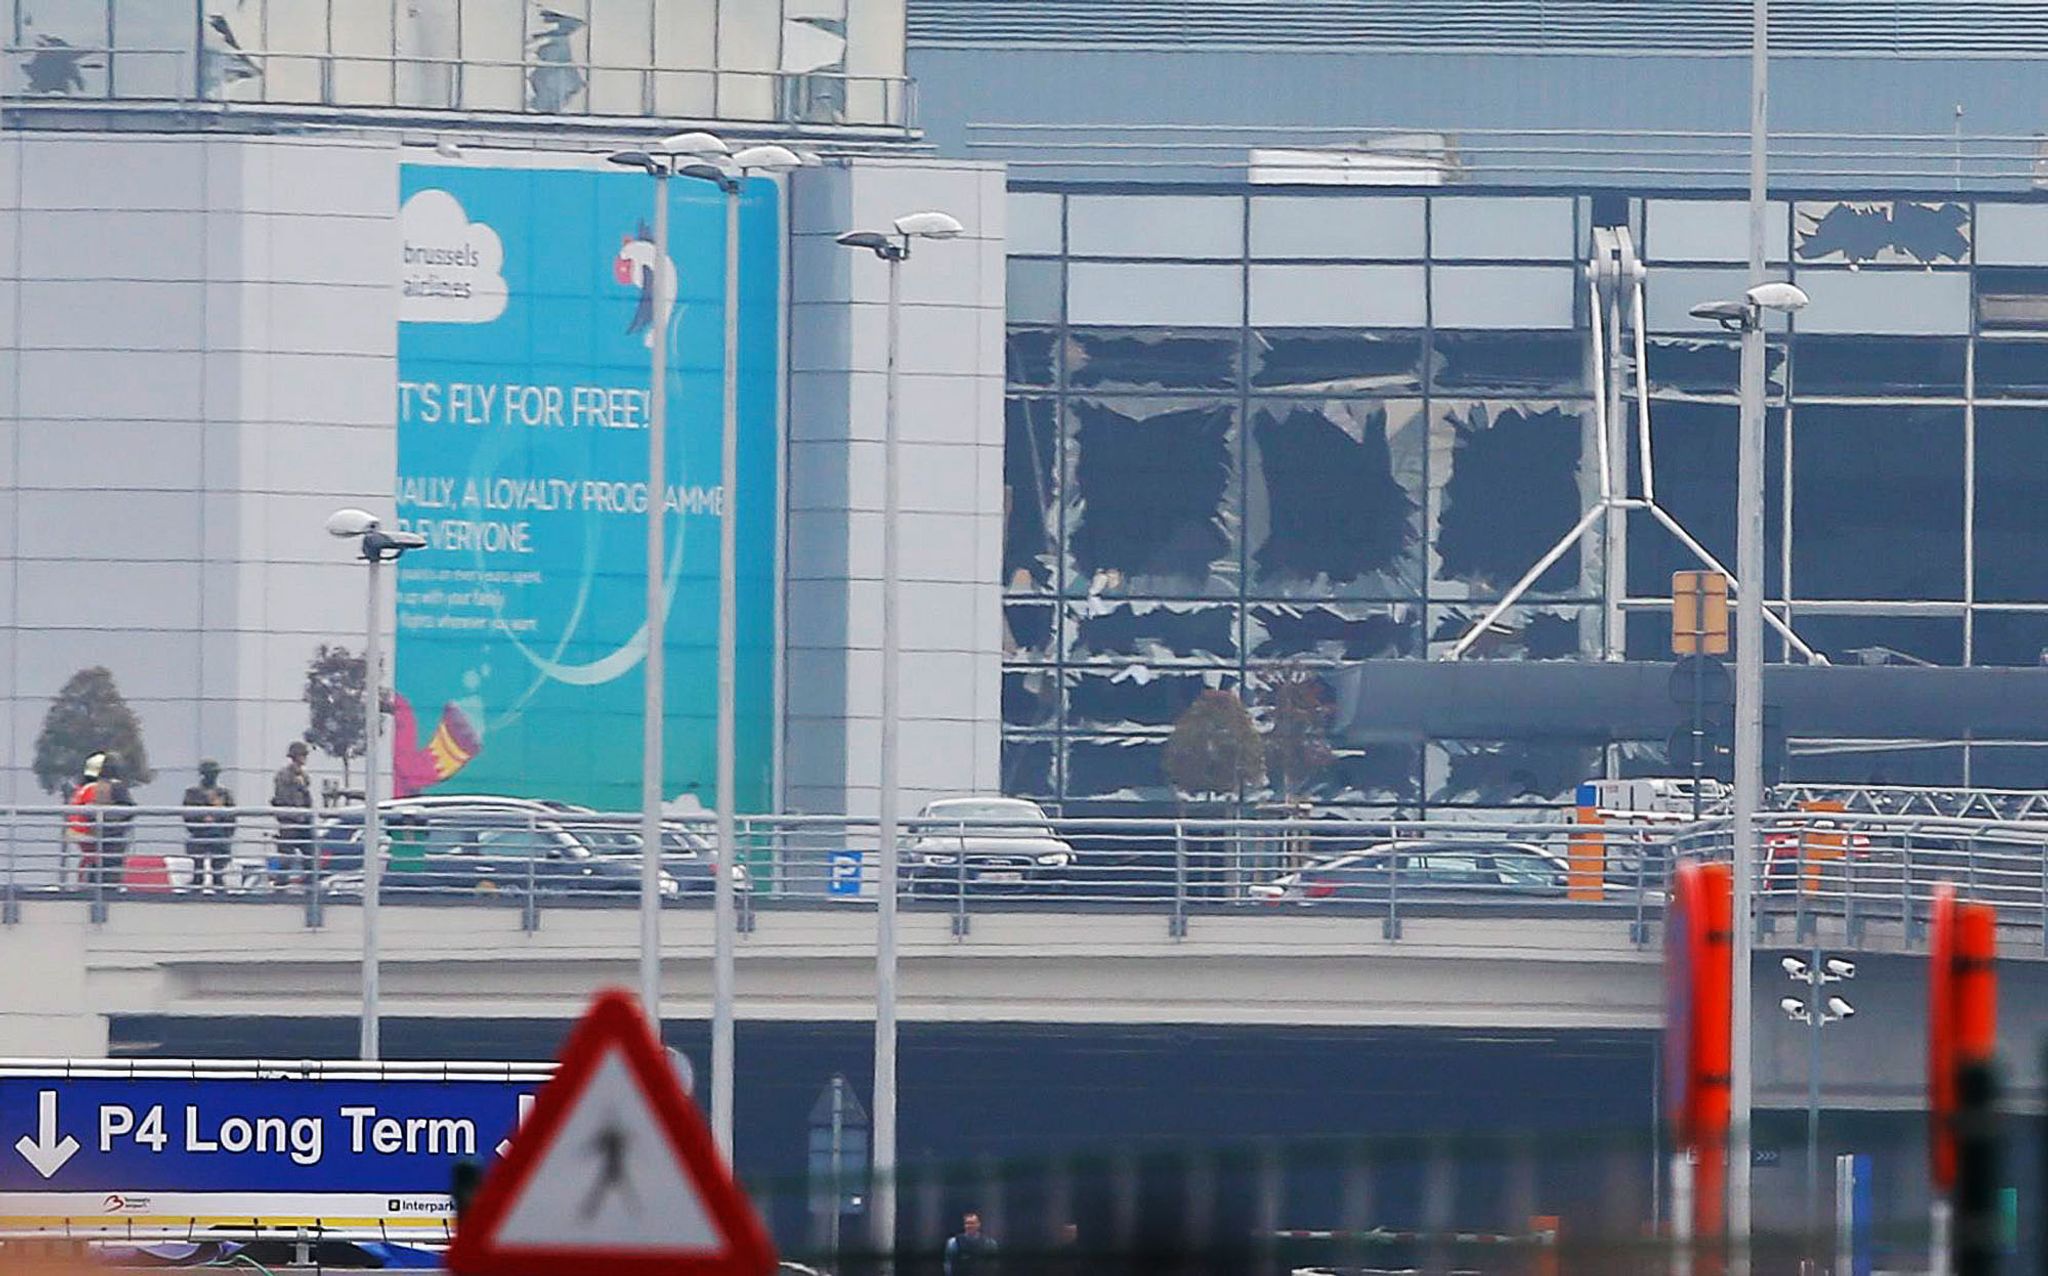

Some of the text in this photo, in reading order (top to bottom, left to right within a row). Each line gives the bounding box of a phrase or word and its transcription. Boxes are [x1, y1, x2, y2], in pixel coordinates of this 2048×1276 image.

[404, 241, 479, 268] brussels
[450, 383, 497, 424] FLY
[505, 385, 565, 427] FOR
[571, 387, 650, 429] FREE!
[462, 477, 481, 508] A
[486, 477, 578, 512] LOYALTY
[582, 479, 724, 517] PROGAMME
[100, 1105, 475, 1164] P4 Long Term
[402, 1200, 457, 1213] Interpark
